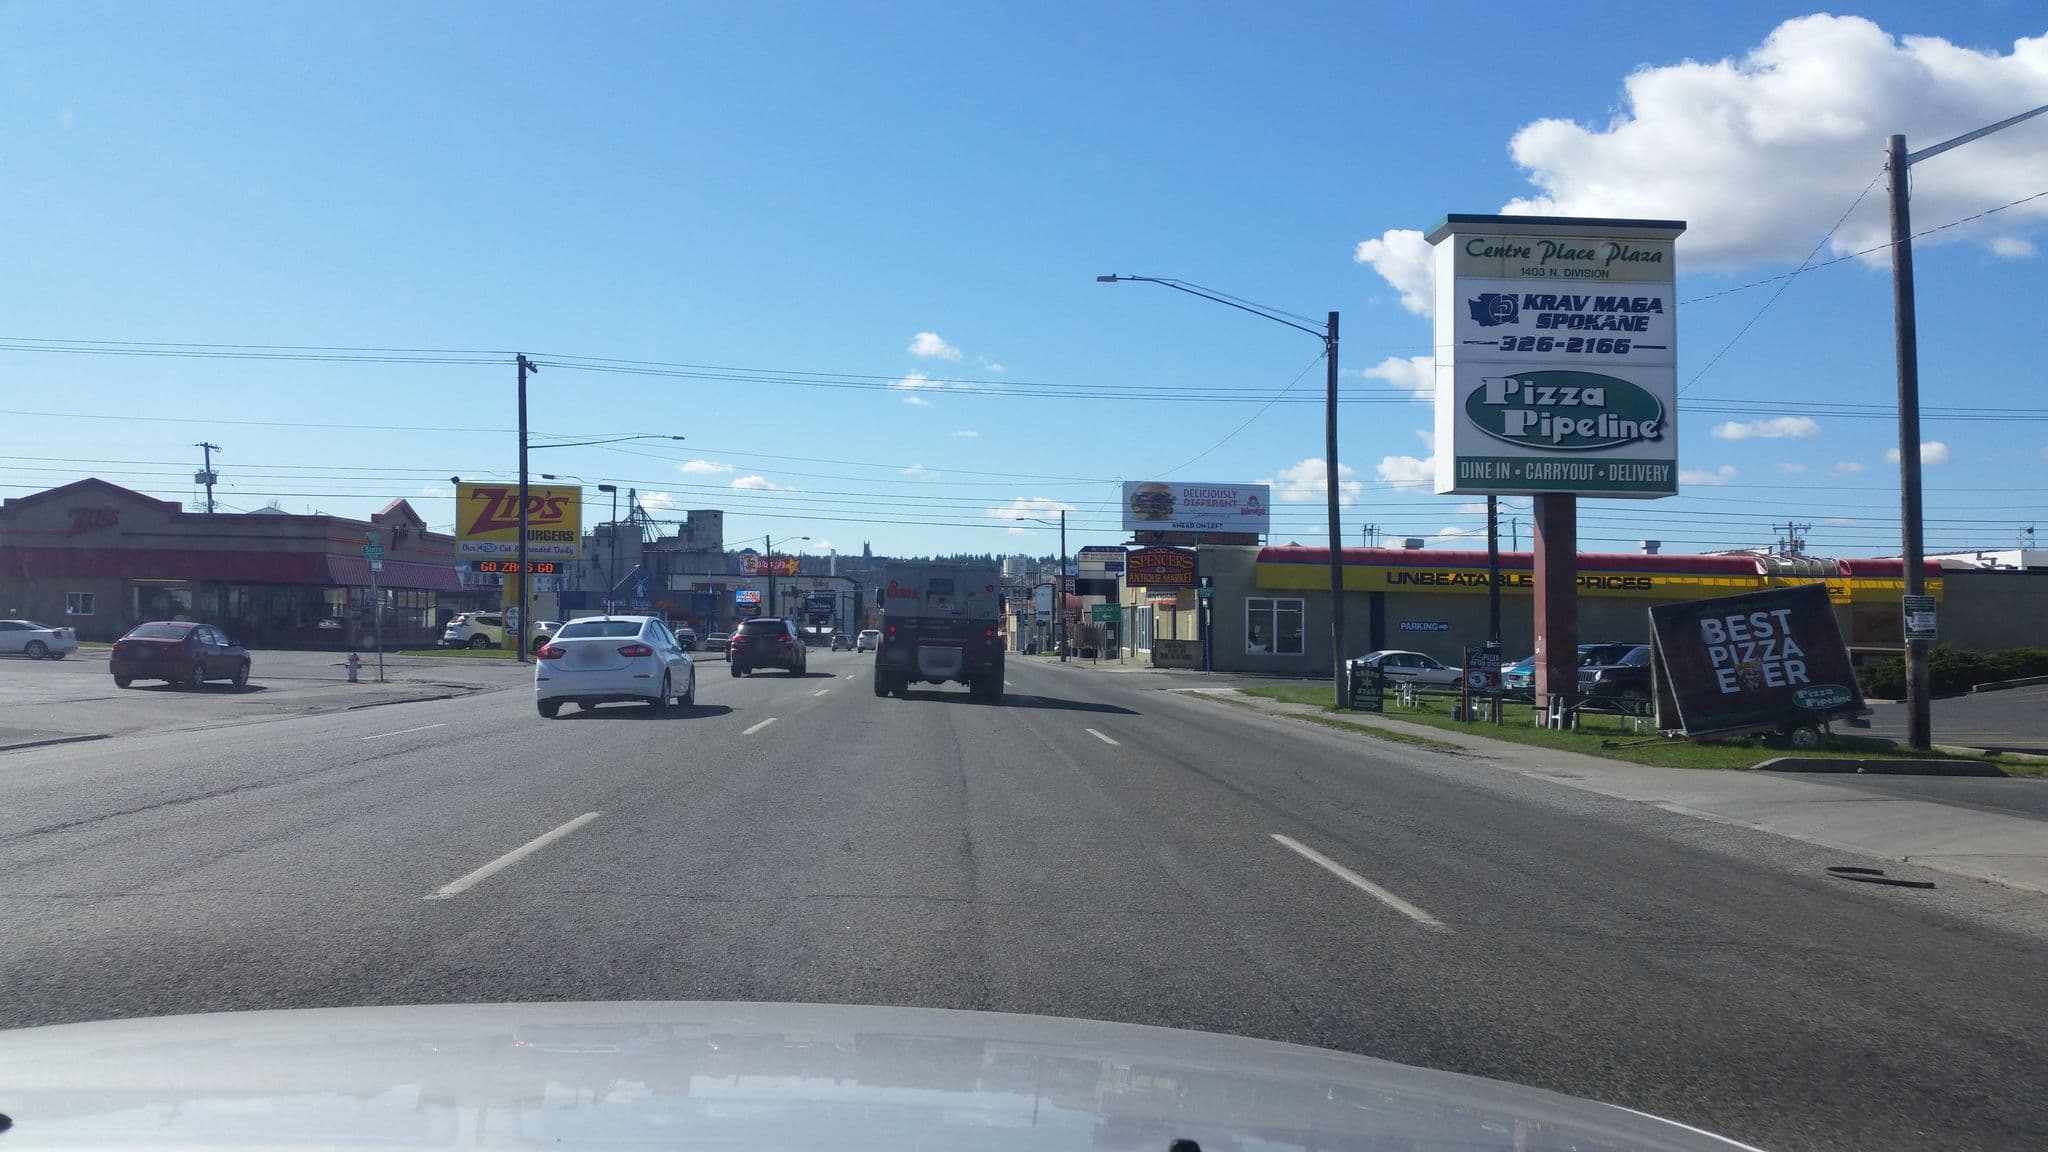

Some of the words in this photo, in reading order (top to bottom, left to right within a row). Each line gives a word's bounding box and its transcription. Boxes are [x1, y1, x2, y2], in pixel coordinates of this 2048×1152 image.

[1465, 238, 1530, 260] Centre
[1537, 240, 1595, 265] Place
[1602, 241, 1663, 266] Plaza
[1521, 267, 1545, 277] 1403
[1549, 268, 1560, 277] N.
[1564, 268, 1609, 278] DIVISION
[1523, 294, 1591, 311] KRAV
[1593, 295, 1663, 313] MAGA
[1536, 313, 1650, 331] SPOKANE
[1500, 336, 1631, 353] 326-2166
[1481, 376, 1605, 407] Pizza
[1501, 409, 1661, 444] Pipeline
[1461, 462, 1493, 478] DINE
[1497, 462, 1510, 479] IN
[1526, 463, 1595, 480] CARRYOUT
[1609, 464, 1669, 482] DELIVERY
[1183, 488, 1238, 499] DELICIOUSLY
[521, 530, 573, 541] URGERS
[481, 562, 496, 571] GO
[537, 563, 554, 573] GO
[1129, 573, 1161, 583] ANTIQUE
[1164, 573, 1192, 584] MARKET
[1387, 571, 1533, 588] UNBEATABLE
[1400, 623, 1438, 631] PARKING
[1700, 608, 1792, 645] BEST
[1708, 637, 1805, 667] PIZZA
[1797, 688, 1833, 699] Pizza
